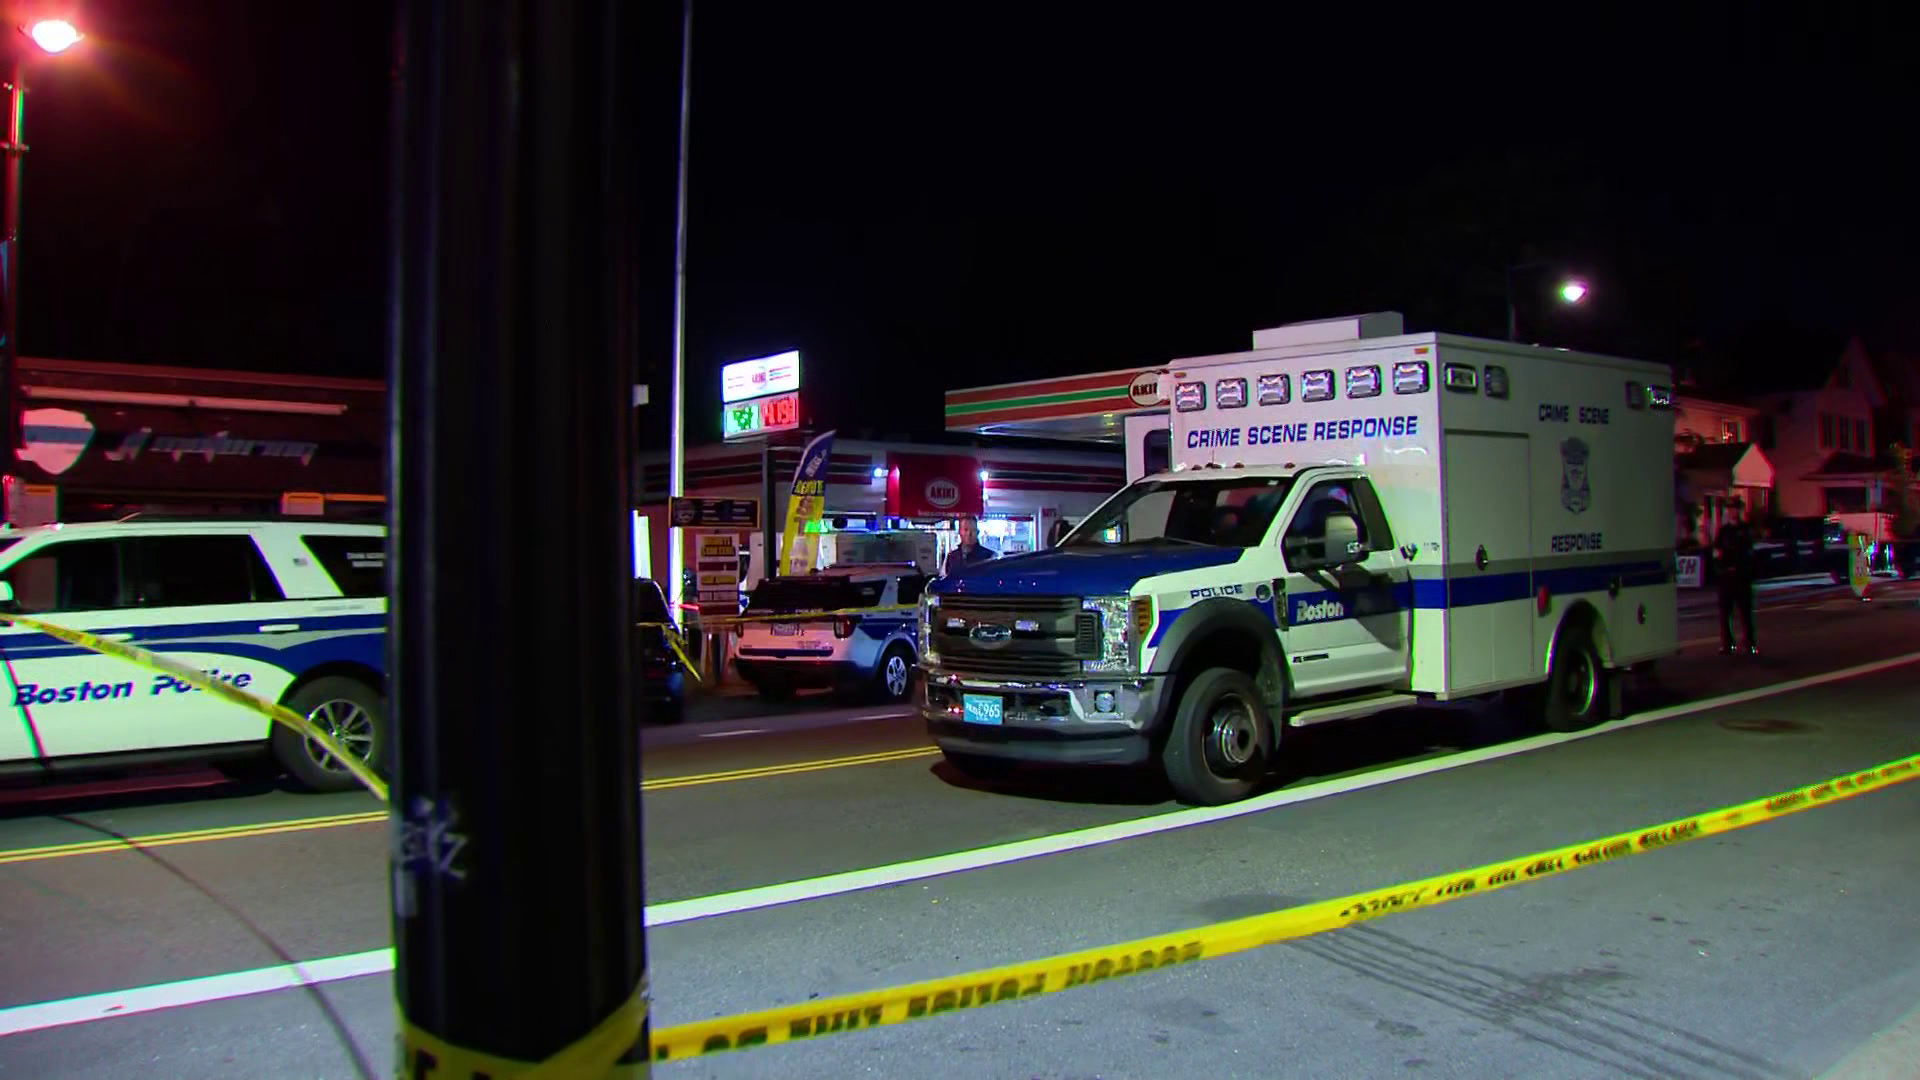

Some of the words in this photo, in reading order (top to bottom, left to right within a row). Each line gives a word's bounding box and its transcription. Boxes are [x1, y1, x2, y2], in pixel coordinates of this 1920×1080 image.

[1538, 404, 1570, 423] CRIME
[1578, 406, 1610, 425] SCENE
[1187, 428, 1241, 449] CRIME
[1247, 423, 1308, 445] SCENE
[1313, 415, 1418, 441] RESPONSE
[929, 486, 956, 500] AKIKI
[1551, 532, 1603, 553] RESPONSE
[1190, 584, 1244, 600] POLICE
[1296, 599, 1345, 623] Boston
[14, 680, 134, 706] Boston
[151, 668, 252, 696] Poie
